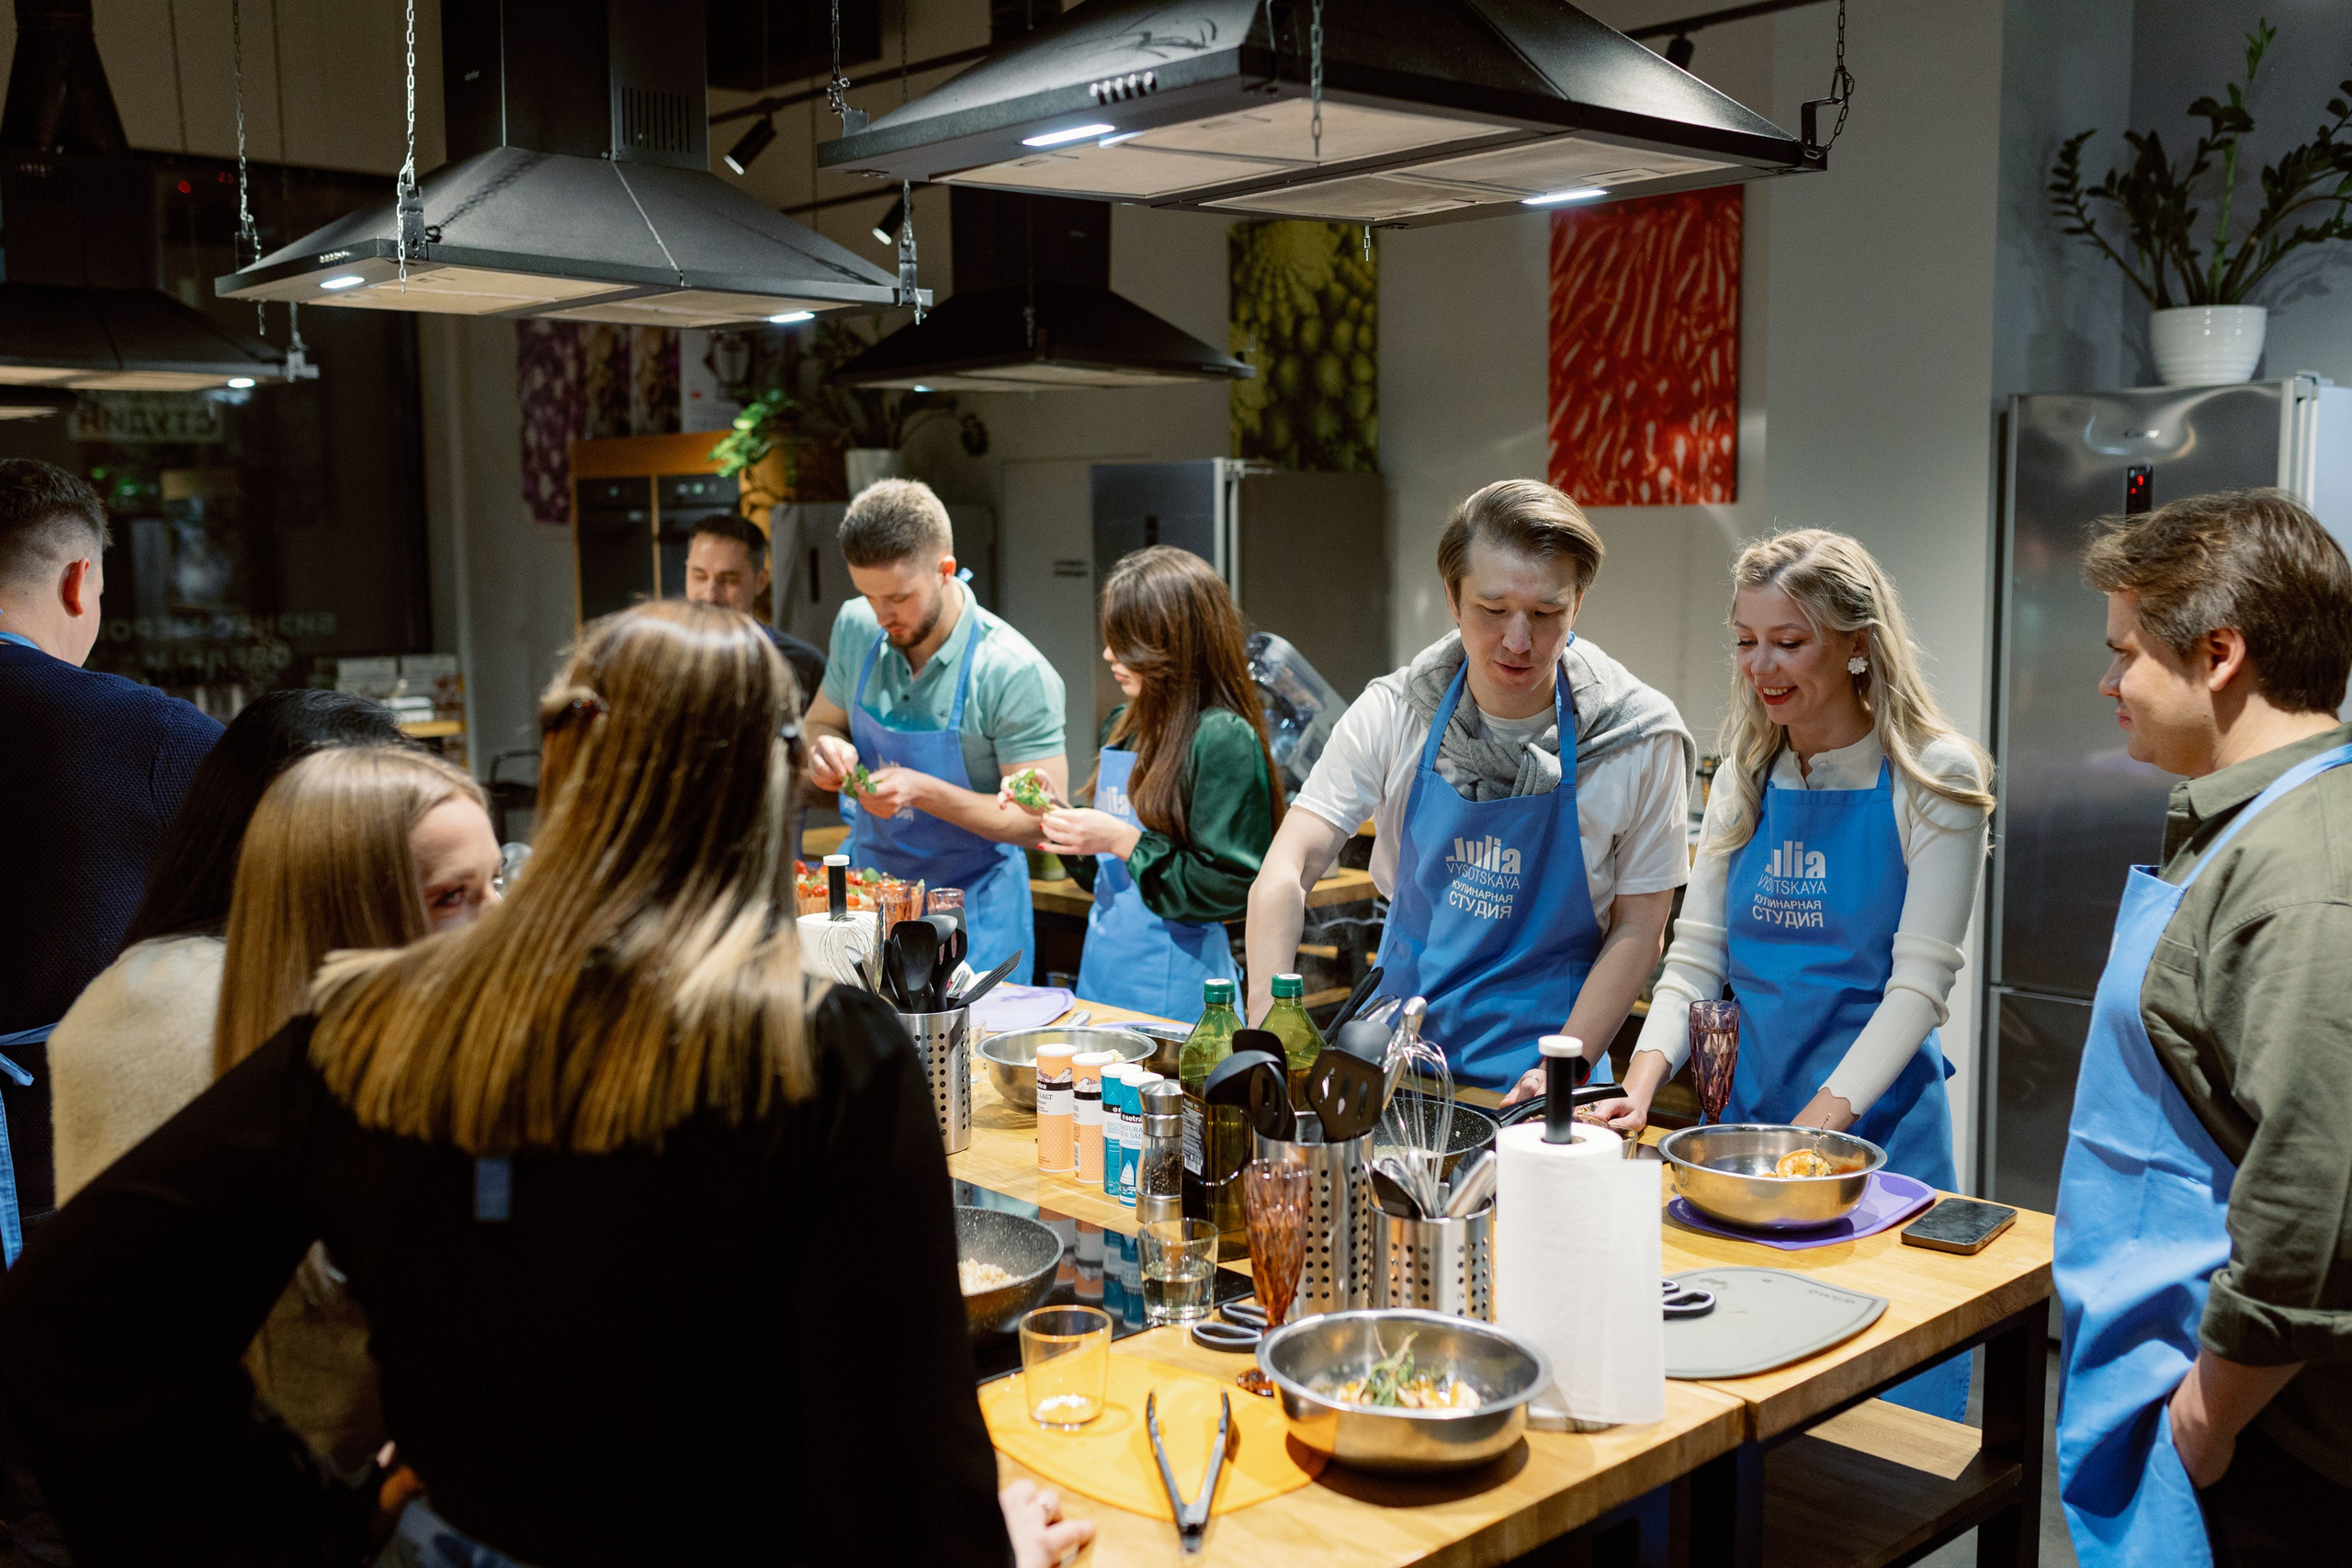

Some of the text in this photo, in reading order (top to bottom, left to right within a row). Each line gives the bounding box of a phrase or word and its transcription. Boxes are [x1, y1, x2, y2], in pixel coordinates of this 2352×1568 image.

[1445, 835, 1521, 874] Julia
[1446, 863, 1521, 890] VYSOTSKAYA
[1758, 874, 1826, 895] VYSTSKAYA
[1452, 879, 1513, 903] КУЛИНАРНАЯ
[1754, 893, 1822, 910] КУЛИНАРНАЯ
[1449, 890, 1512, 919] СТУДИЯ
[1752, 905, 1824, 929] СТУДИЯ
[1121, 1124, 1144, 1133] ATURA
